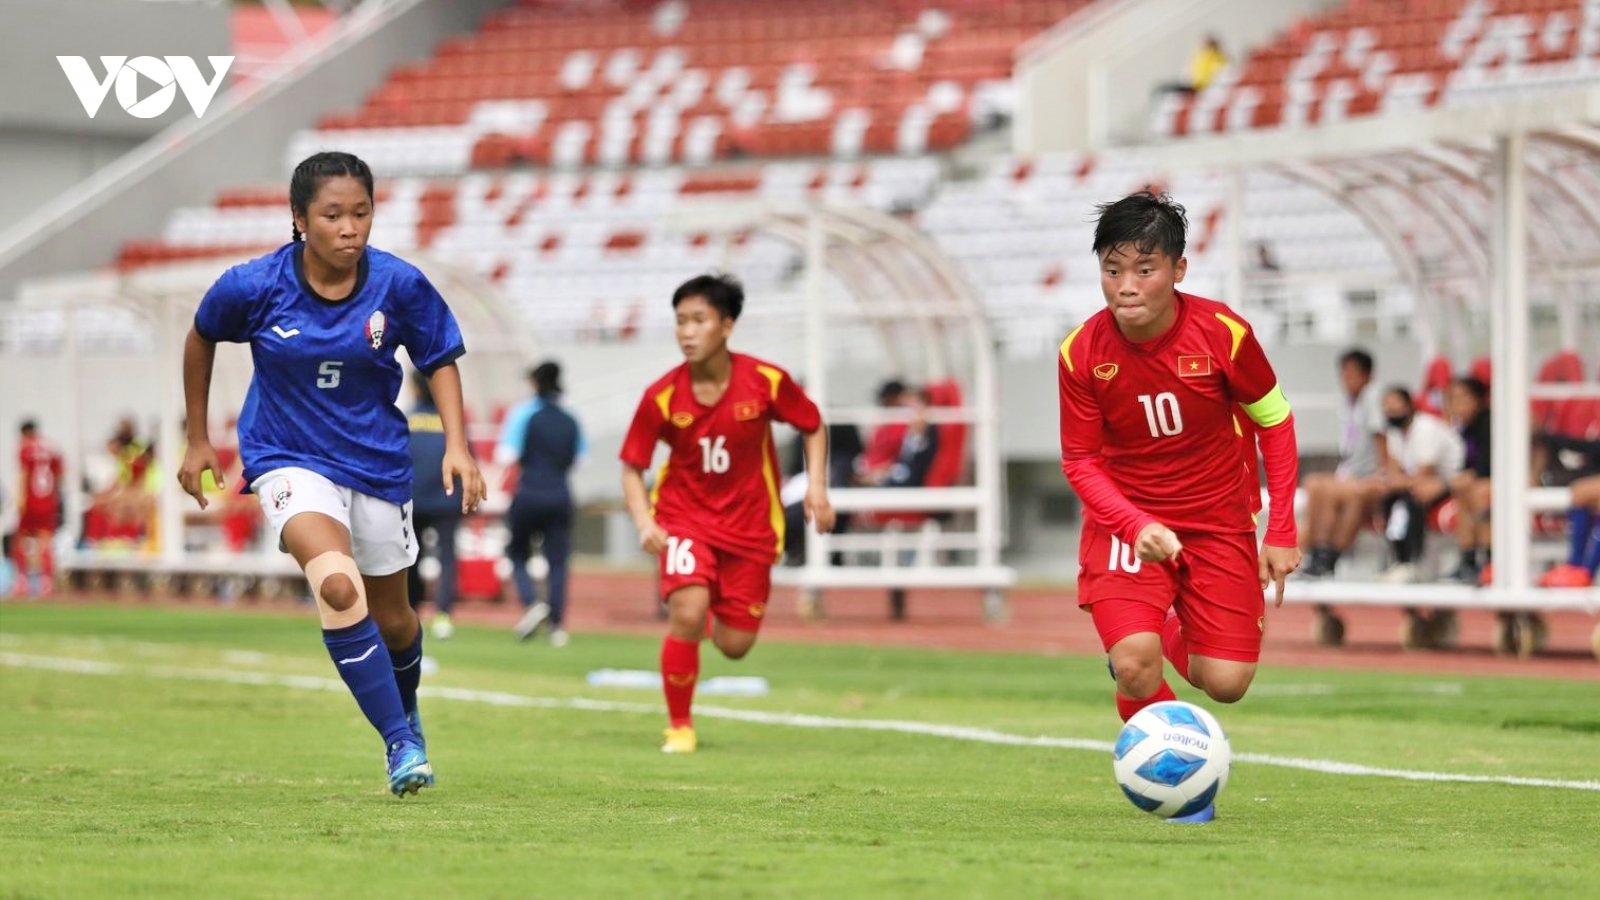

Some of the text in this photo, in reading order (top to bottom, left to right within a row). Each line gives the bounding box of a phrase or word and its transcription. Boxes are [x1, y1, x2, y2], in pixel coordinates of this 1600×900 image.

[316, 361, 344, 389] 5
[1138, 391, 1184, 438] 10
[698, 435, 731, 474] 16
[665, 536, 697, 576] 16
[1162, 732, 1209, 751] molten
